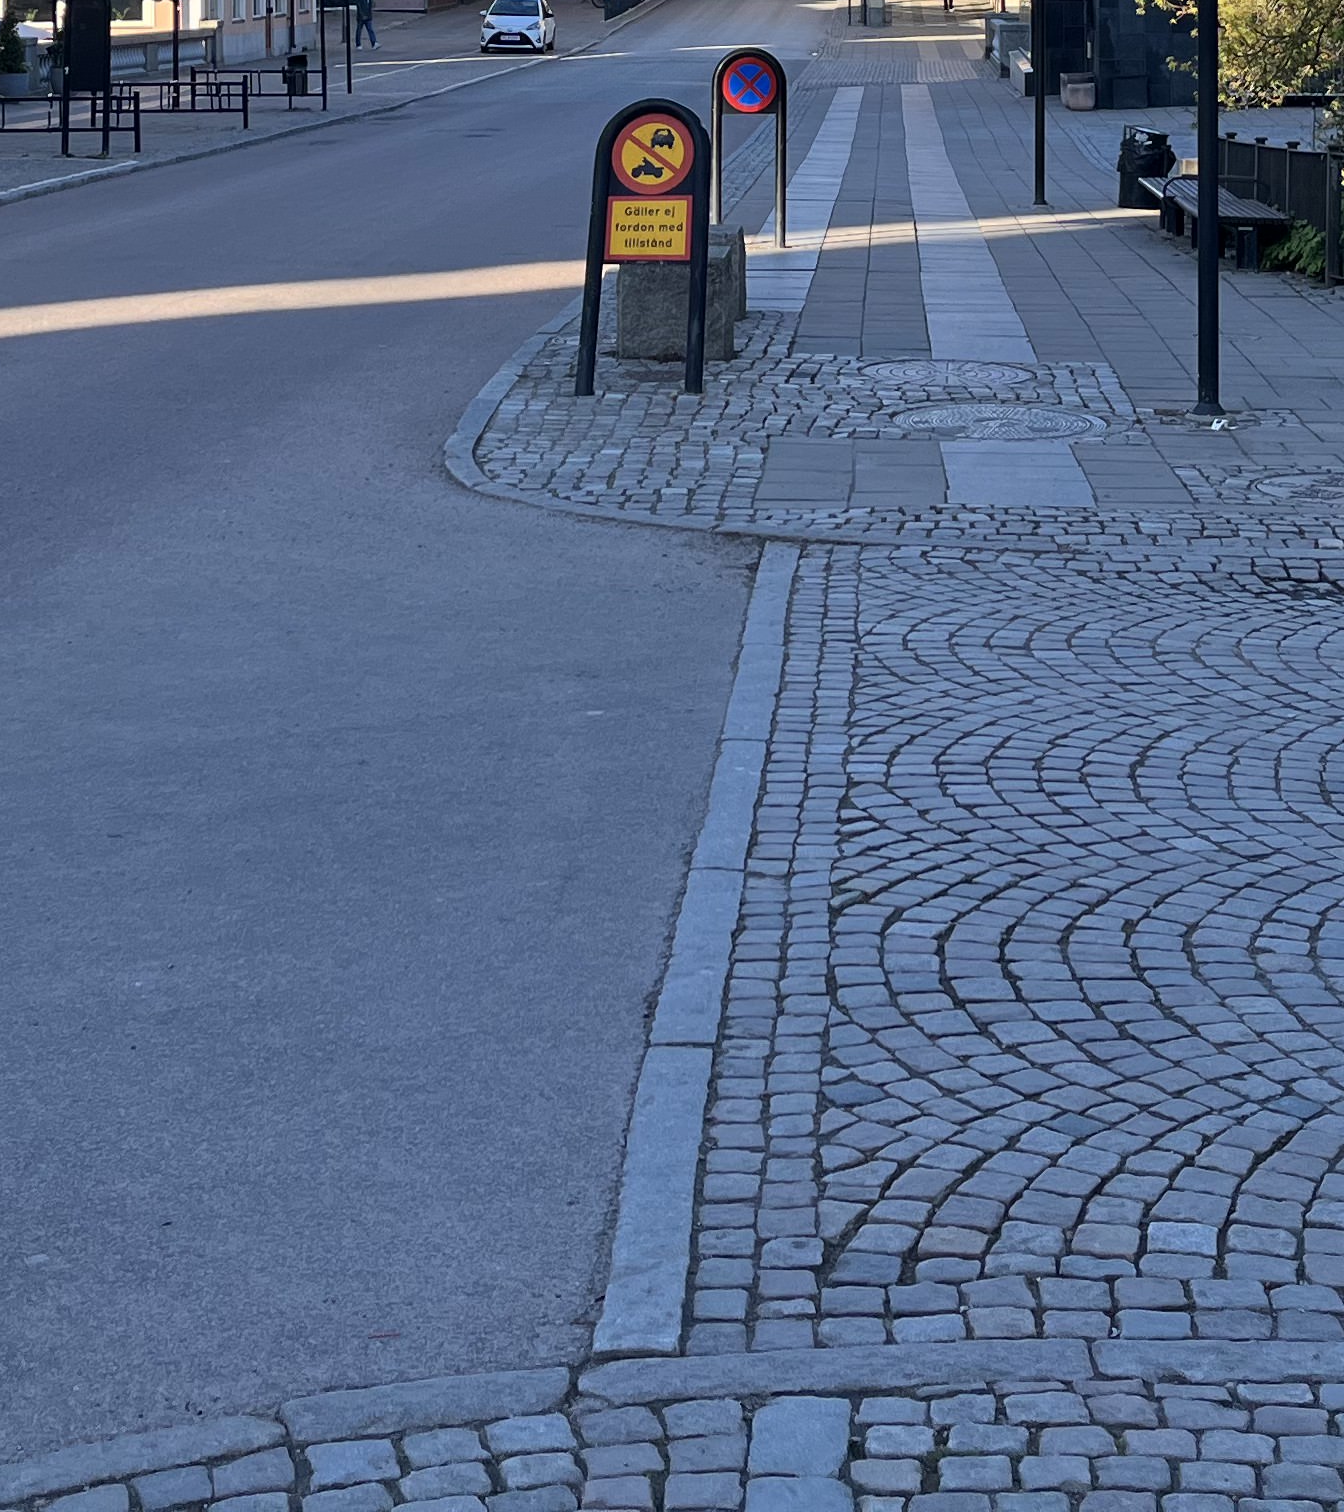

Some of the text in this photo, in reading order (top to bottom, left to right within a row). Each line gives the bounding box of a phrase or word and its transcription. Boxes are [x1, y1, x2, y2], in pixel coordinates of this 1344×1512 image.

[624, 205, 676, 217] Gäller ej
[615, 221, 684, 232] fordon med
[624, 237, 673, 248] tillstånd
